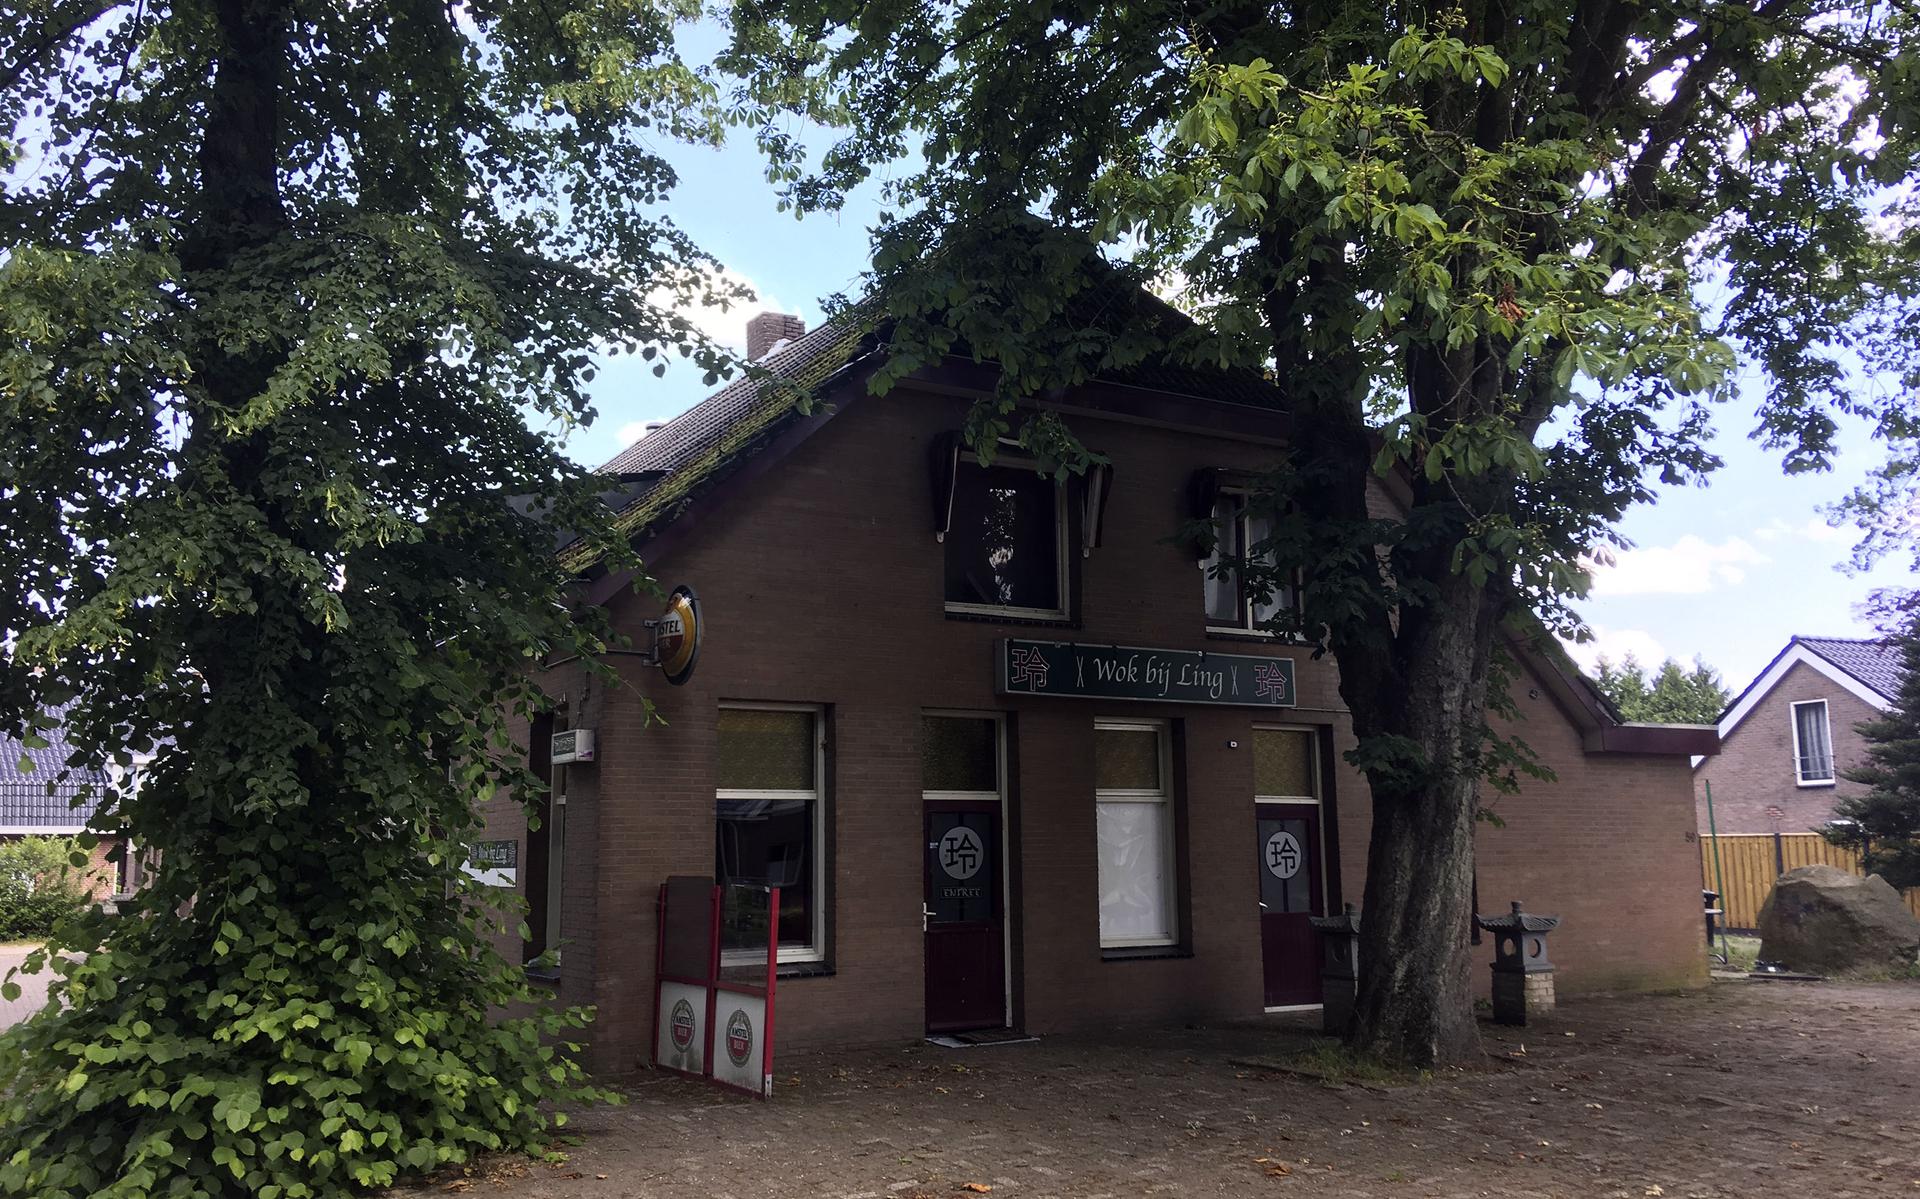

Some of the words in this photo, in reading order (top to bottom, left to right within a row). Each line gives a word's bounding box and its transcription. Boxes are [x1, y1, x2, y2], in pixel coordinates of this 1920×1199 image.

[659, 620, 681, 635] STEL
[1011, 646, 1050, 692] 玲
[1093, 654, 1139, 683] Wok
[1145, 655, 1172, 697] bij
[1176, 662, 1223, 699] Ling
[1254, 661, 1288, 704] 玲
[945, 833, 979, 874] 玲
[1270, 838, 1298, 874] 玲
[731, 1027, 749, 1039] AMSTEL
